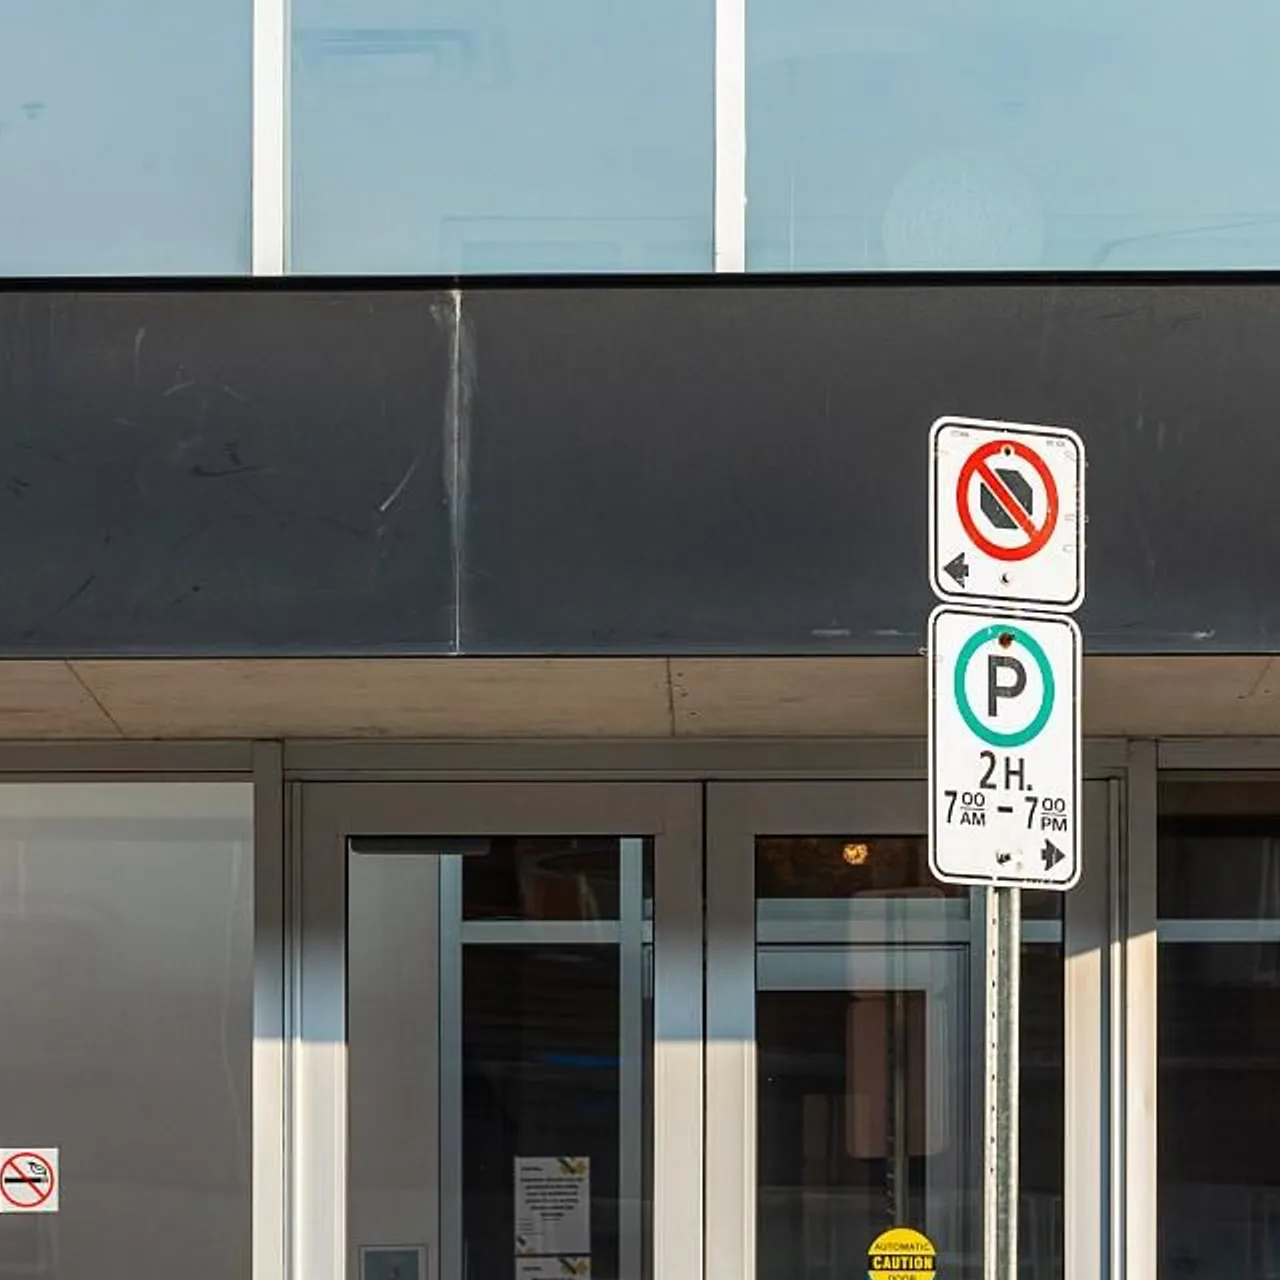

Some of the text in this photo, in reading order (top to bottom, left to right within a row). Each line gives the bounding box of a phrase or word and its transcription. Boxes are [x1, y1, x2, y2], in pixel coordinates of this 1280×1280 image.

[987, 654, 1028, 718] P
[960, 811, 986, 827] AM
[1040, 816, 1068, 833] PM
[873, 1241, 932, 1252] AUTOMATIC
[872, 1255, 934, 1270] CAUTION
